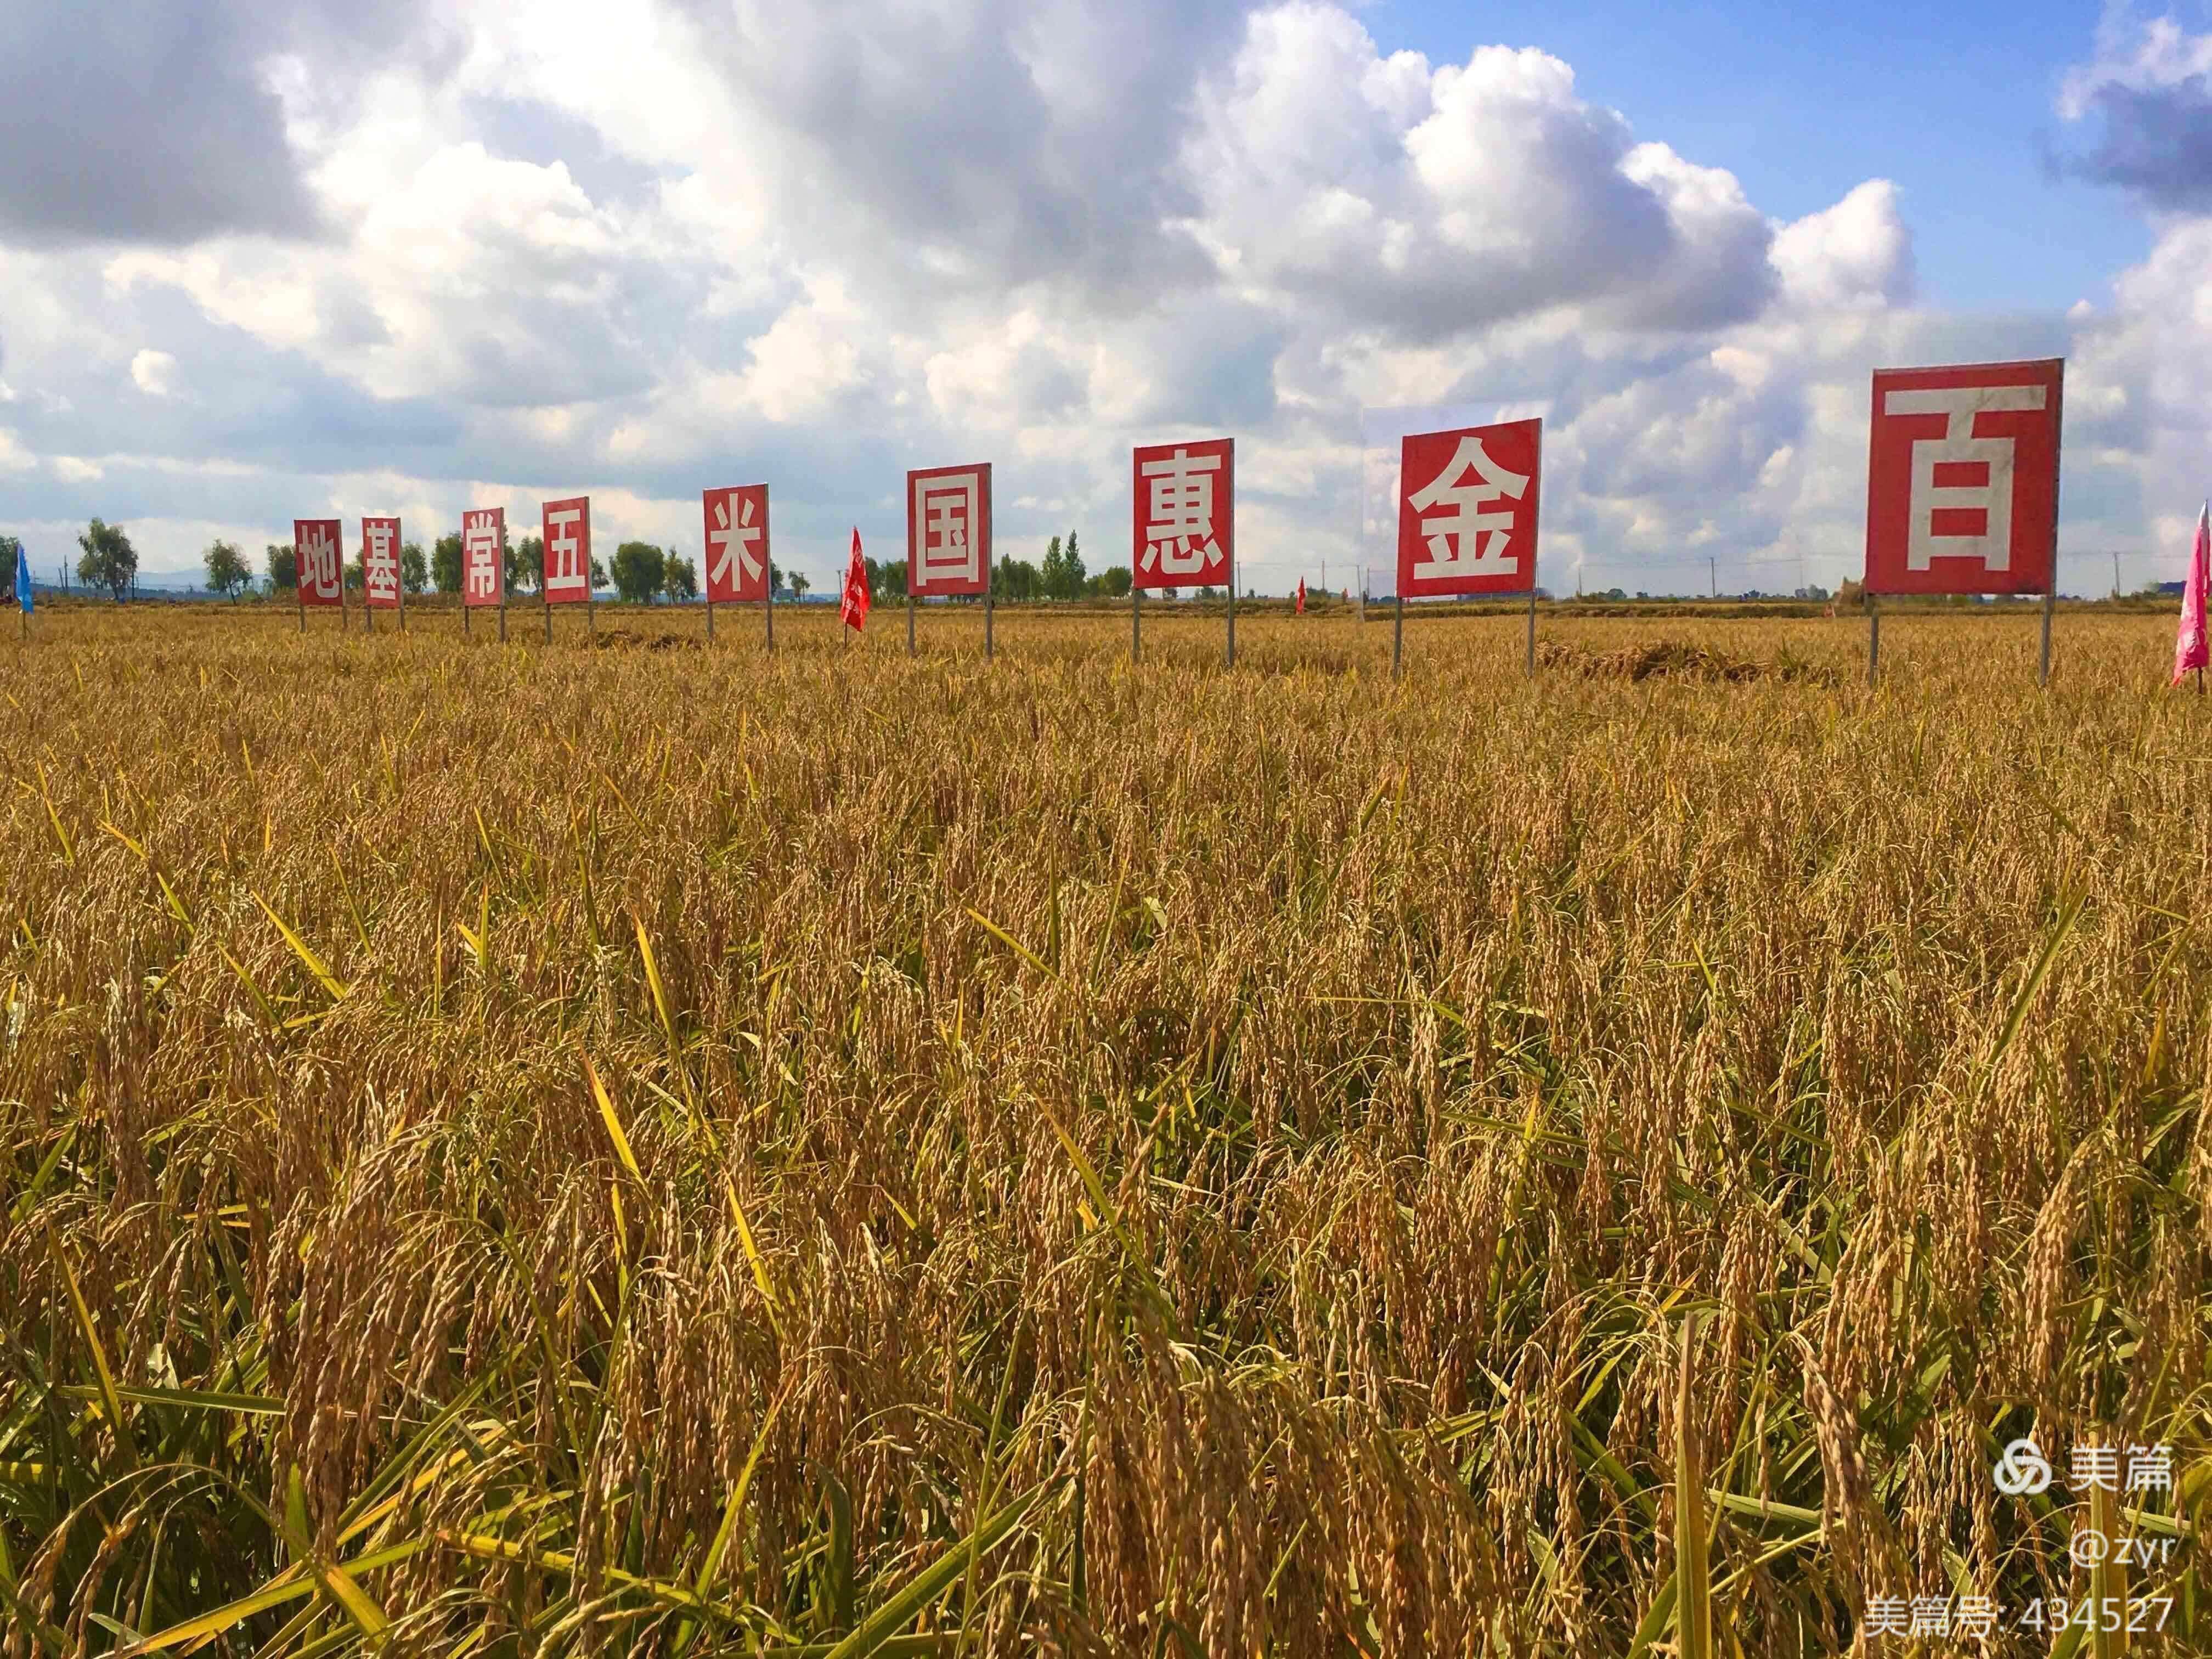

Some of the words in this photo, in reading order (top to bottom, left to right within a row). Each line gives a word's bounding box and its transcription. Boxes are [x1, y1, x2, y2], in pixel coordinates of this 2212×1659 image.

[1139, 449, 1224, 574] 惠
[1408, 436, 1530, 579] 金
[1884, 385, 2047, 572] 百
[298, 524, 339, 598] 地
[366, 522, 398, 600] 基
[466, 512, 498, 597] 常
[547, 509, 585, 589] 五
[710, 493, 763, 592] 米
[915, 473, 979, 586] 国
